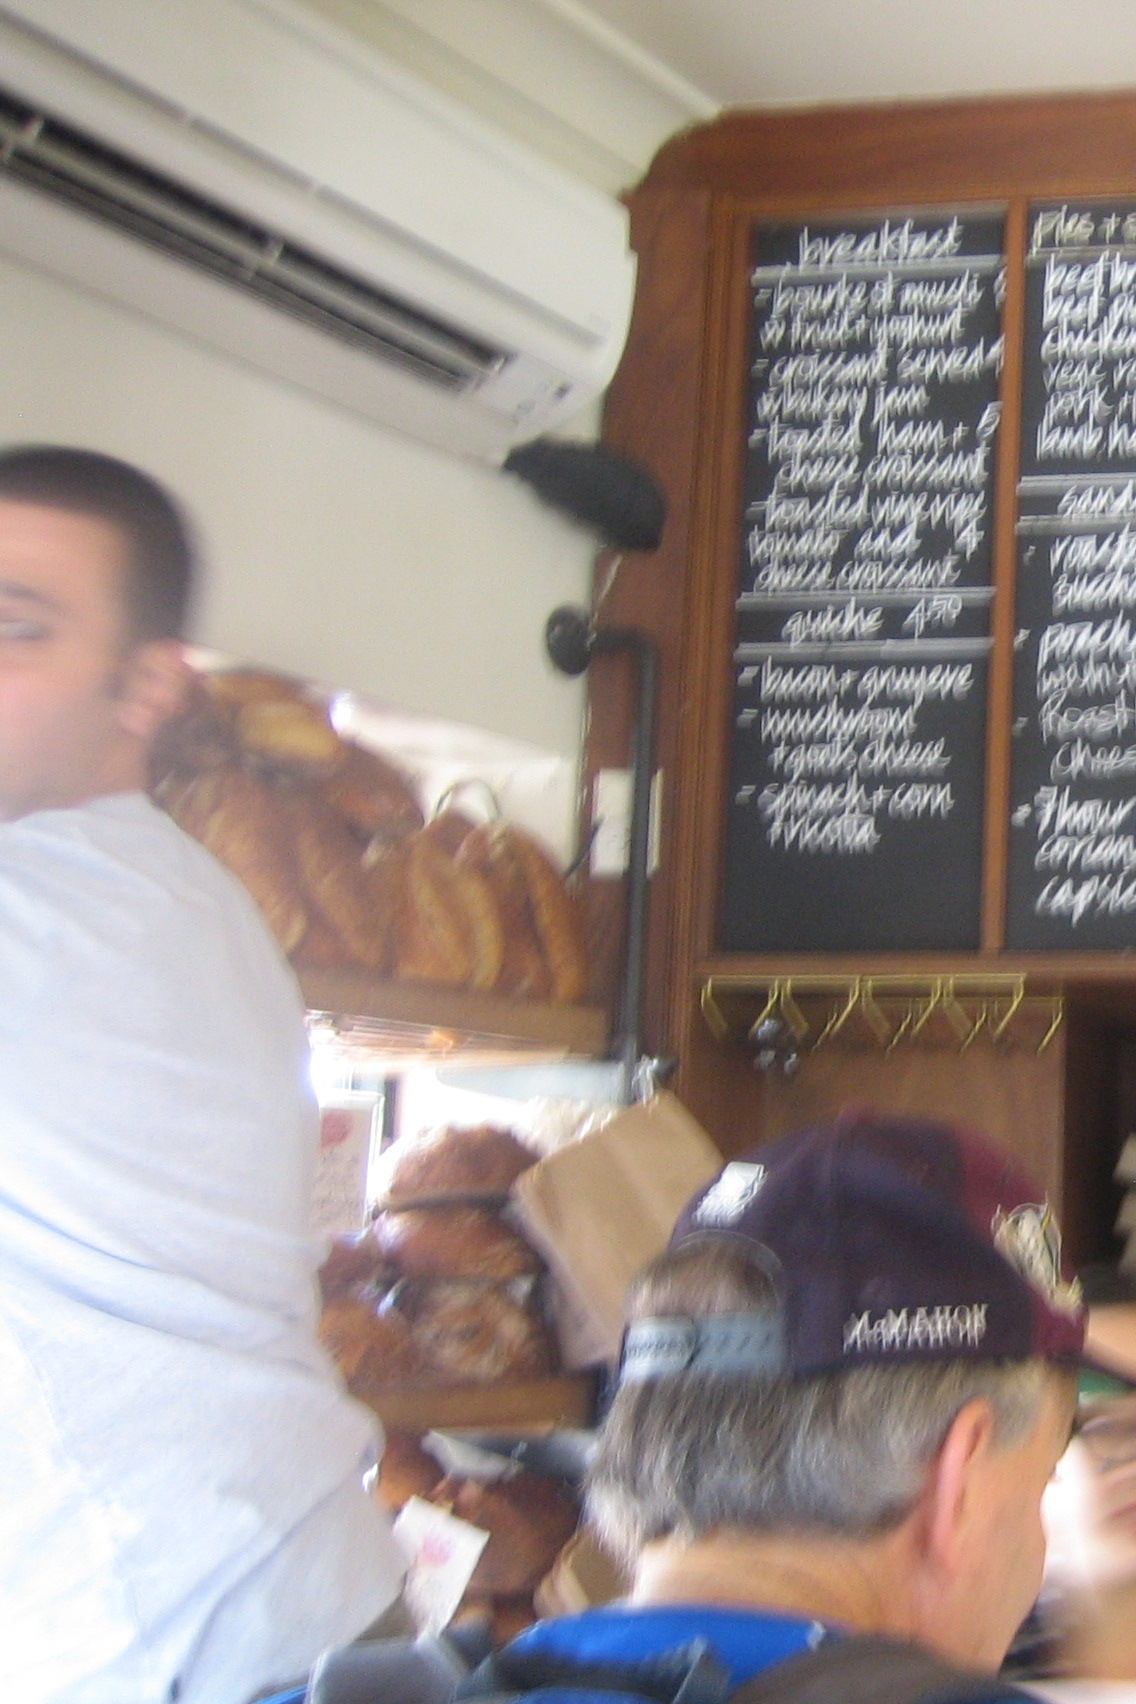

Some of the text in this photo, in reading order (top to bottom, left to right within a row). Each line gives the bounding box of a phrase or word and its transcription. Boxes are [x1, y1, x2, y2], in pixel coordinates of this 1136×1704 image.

[800, 216, 964, 264] breakfast
[896, 334, 985, 386] served
[1044, 384, 1112, 434] pork
[767, 414, 863, 465] toasted
[877, 411, 948, 455] ham
[773, 447, 990, 493] cheese croissant
[764, 485, 871, 533] toasted
[780, 597, 884, 648] quiche
[760, 694, 919, 745] mushroom
[857, 735, 951, 779] cheese
